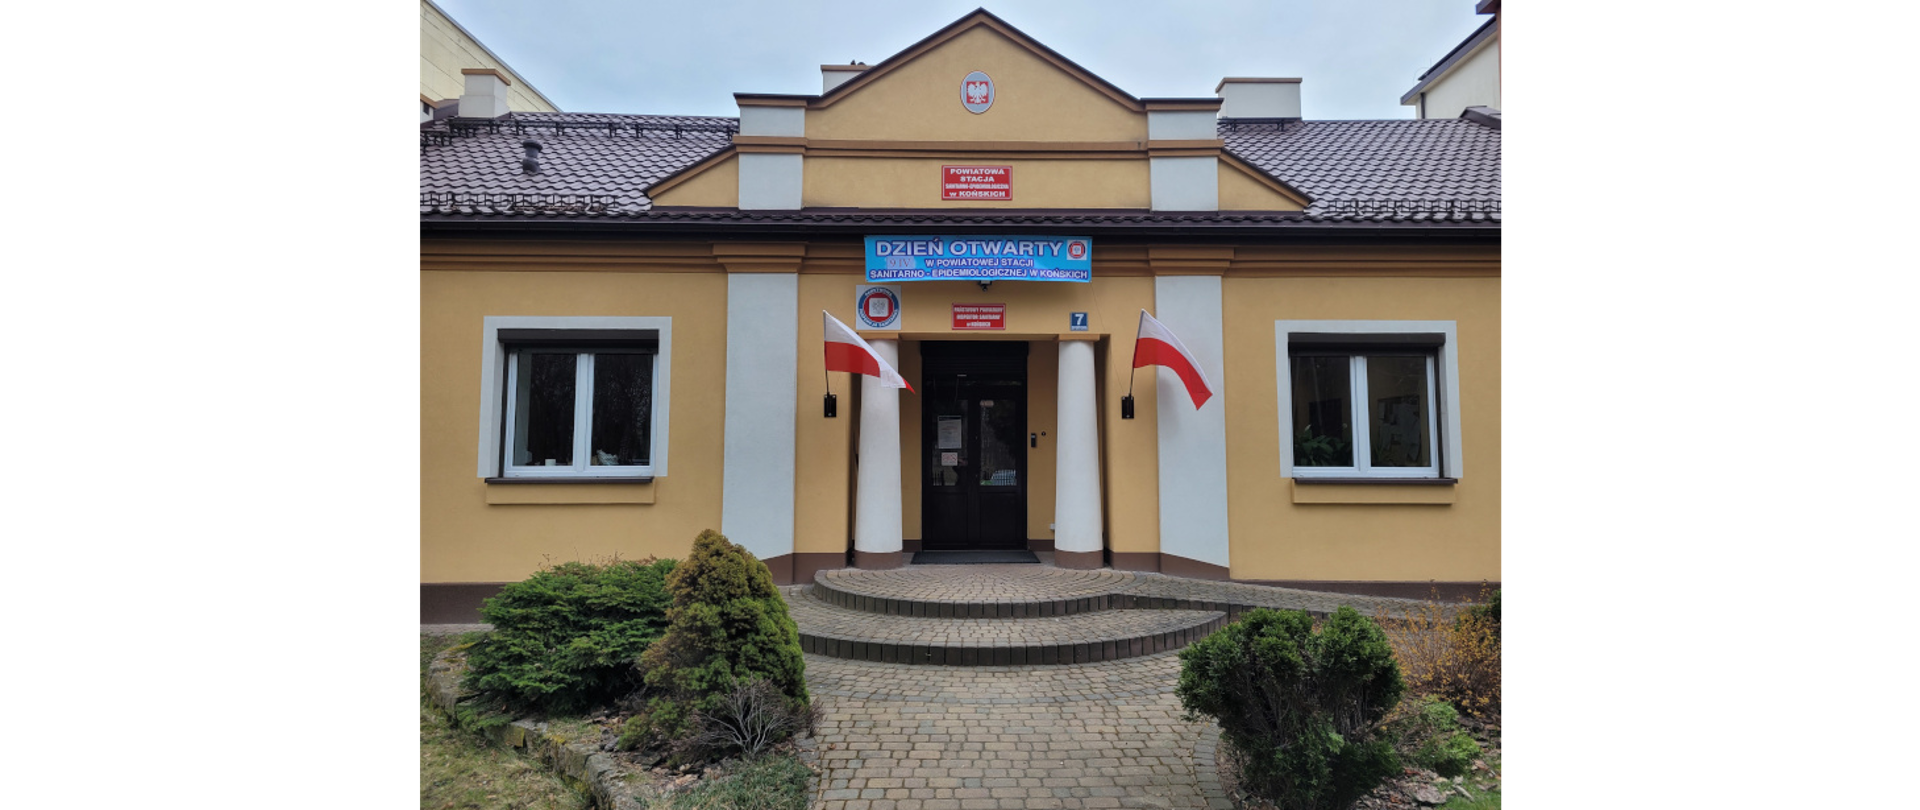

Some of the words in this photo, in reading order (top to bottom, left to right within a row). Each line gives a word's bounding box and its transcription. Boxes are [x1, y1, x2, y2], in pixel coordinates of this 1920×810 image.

[876, 238, 944, 256] DZIEŃ
[949, 240, 1064, 256] OTWARTY
[889, 258, 896, 267] 9
[899, 258, 911, 267] IV
[925, 258, 934, 267] W
[936, 258, 999, 267] POWIATOWEJ
[1001, 258, 1034, 267] STACJI
[870, 269, 925, 278] SANITARNO
[932, 268, 1027, 278] EPIDEMIOLOGICZNEJ
[1029, 269, 1038, 277] W
[1039, 268, 1087, 278] KOŃSKICH
[1075, 313, 1084, 326] 7
